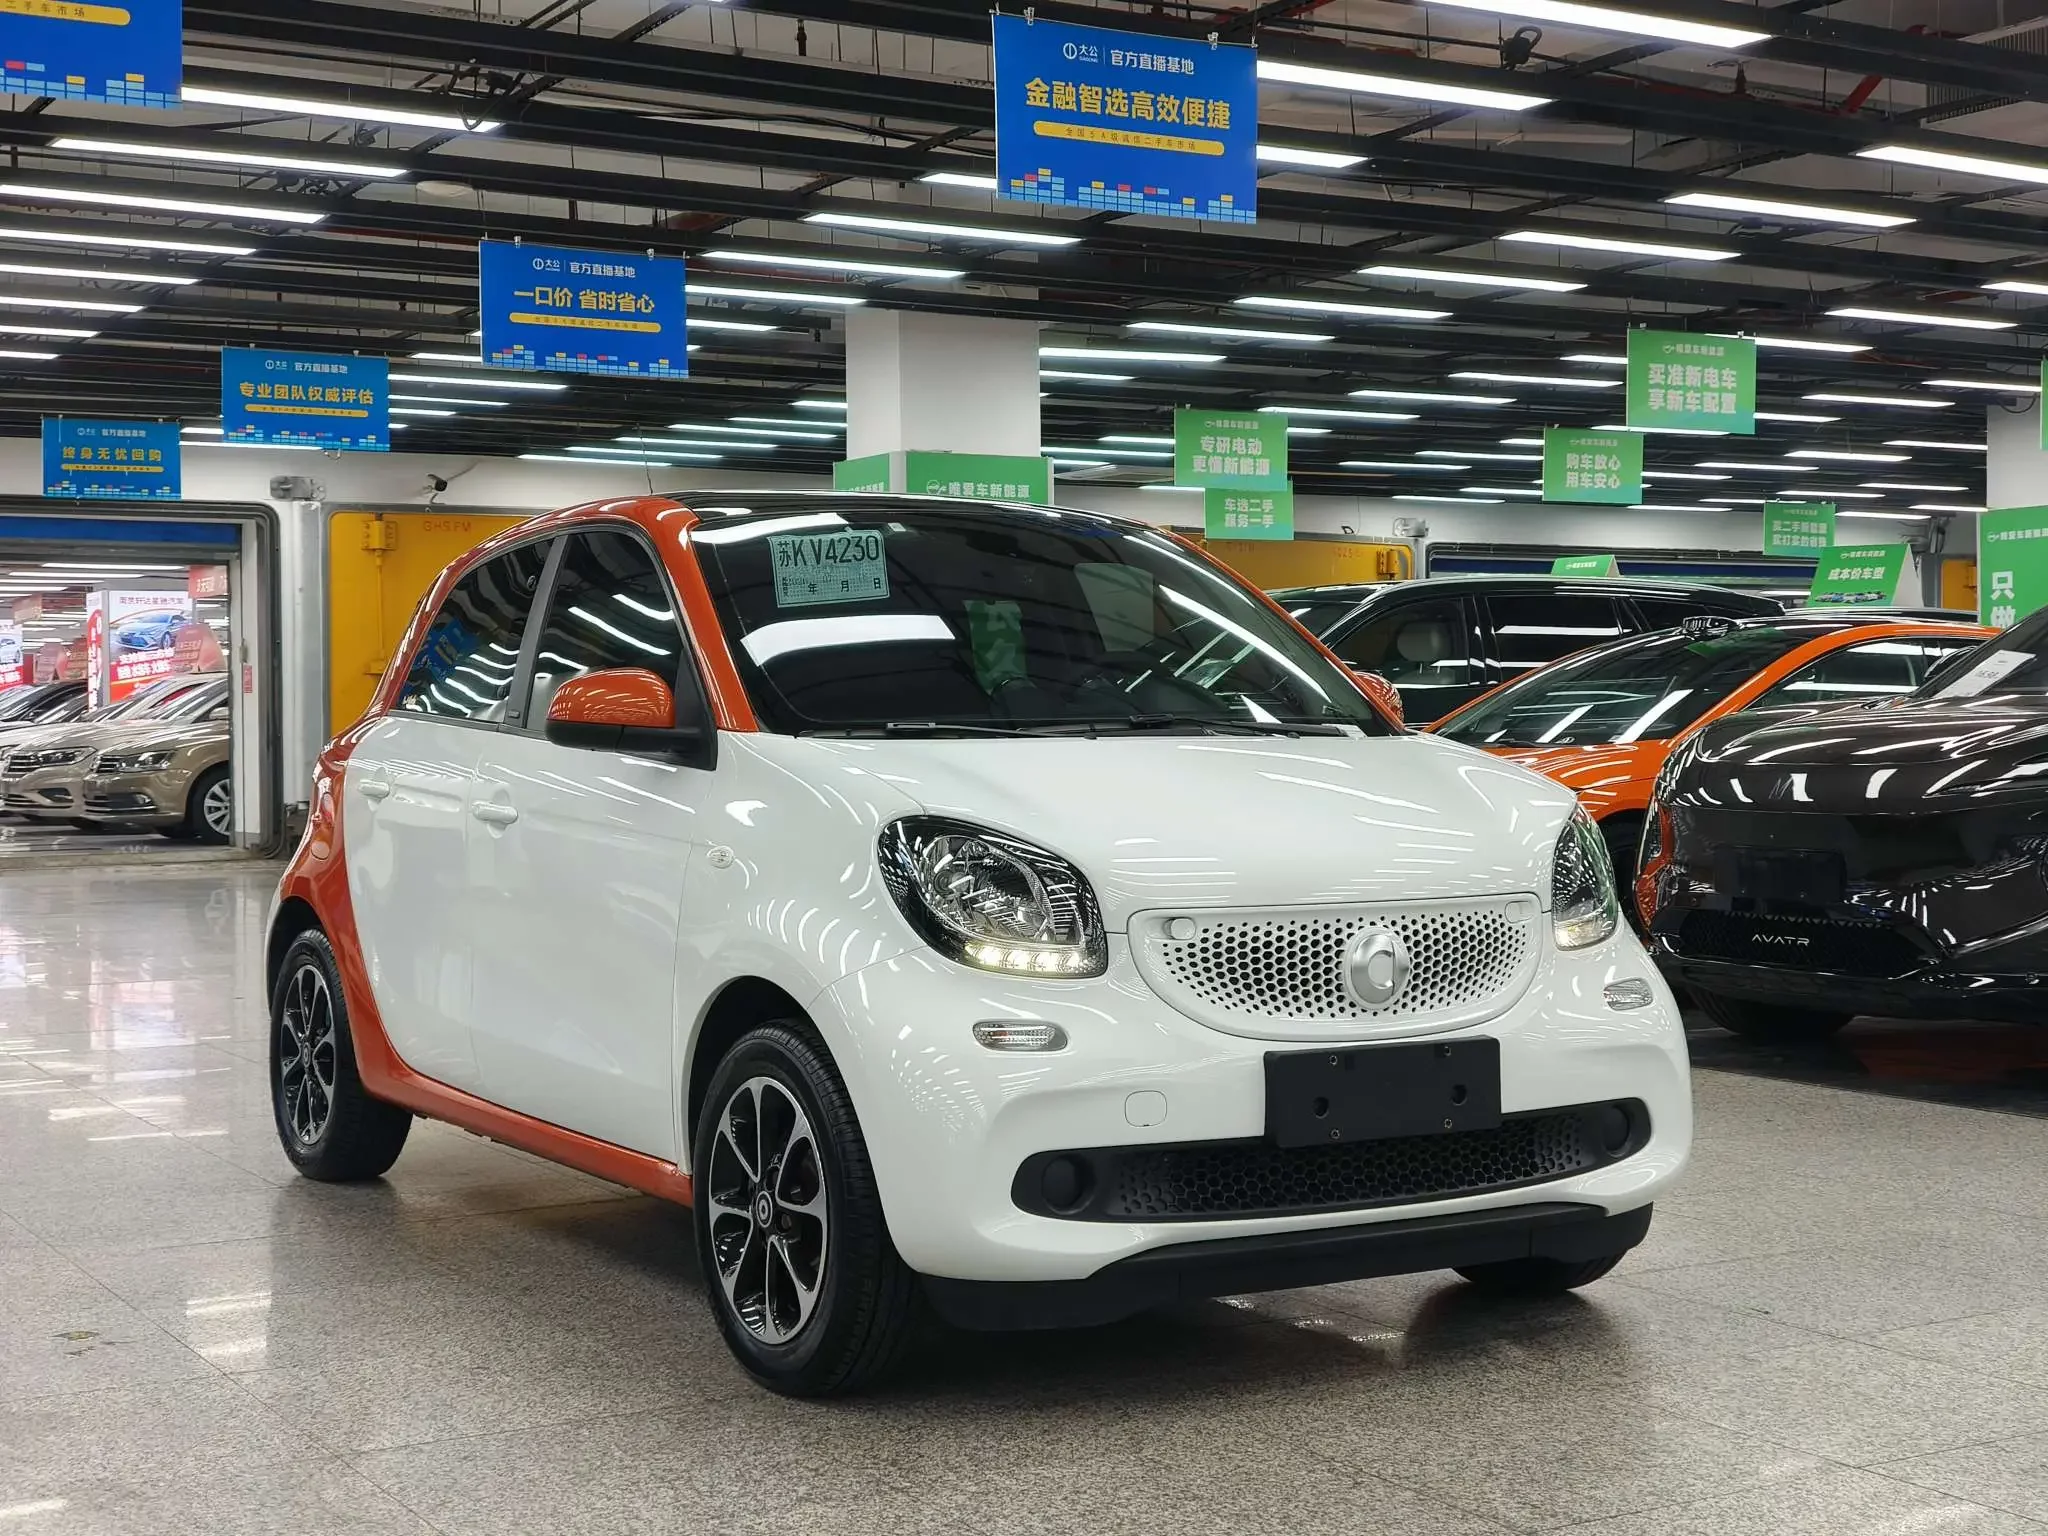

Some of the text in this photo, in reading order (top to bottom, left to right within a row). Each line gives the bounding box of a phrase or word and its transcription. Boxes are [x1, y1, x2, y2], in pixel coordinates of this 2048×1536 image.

[1110, 49, 1195, 75] 官方直播基地
[1025, 77, 1231, 130] 金融智选高效便捷
[569, 261, 637, 279] 官方直播基地
[514, 286, 655, 314] 一口价 省时省心
[1648, 363, 1738, 390] 买准新电车
[239, 381, 375, 405] 专业团队权威评估
[1648, 388, 1738, 415] 享新车配置
[1200, 435, 1263, 456] 专研电动
[1566, 453, 1621, 471] 购车放心
[1566, 471, 1621, 489] 用车安心
[1224, 498, 1274, 513] 车选二手
[777, 535, 880, 567] 苏KV4230
[808, 577, 881, 594] 年 月 日
[1751, 933, 1810, 946] AVATR
